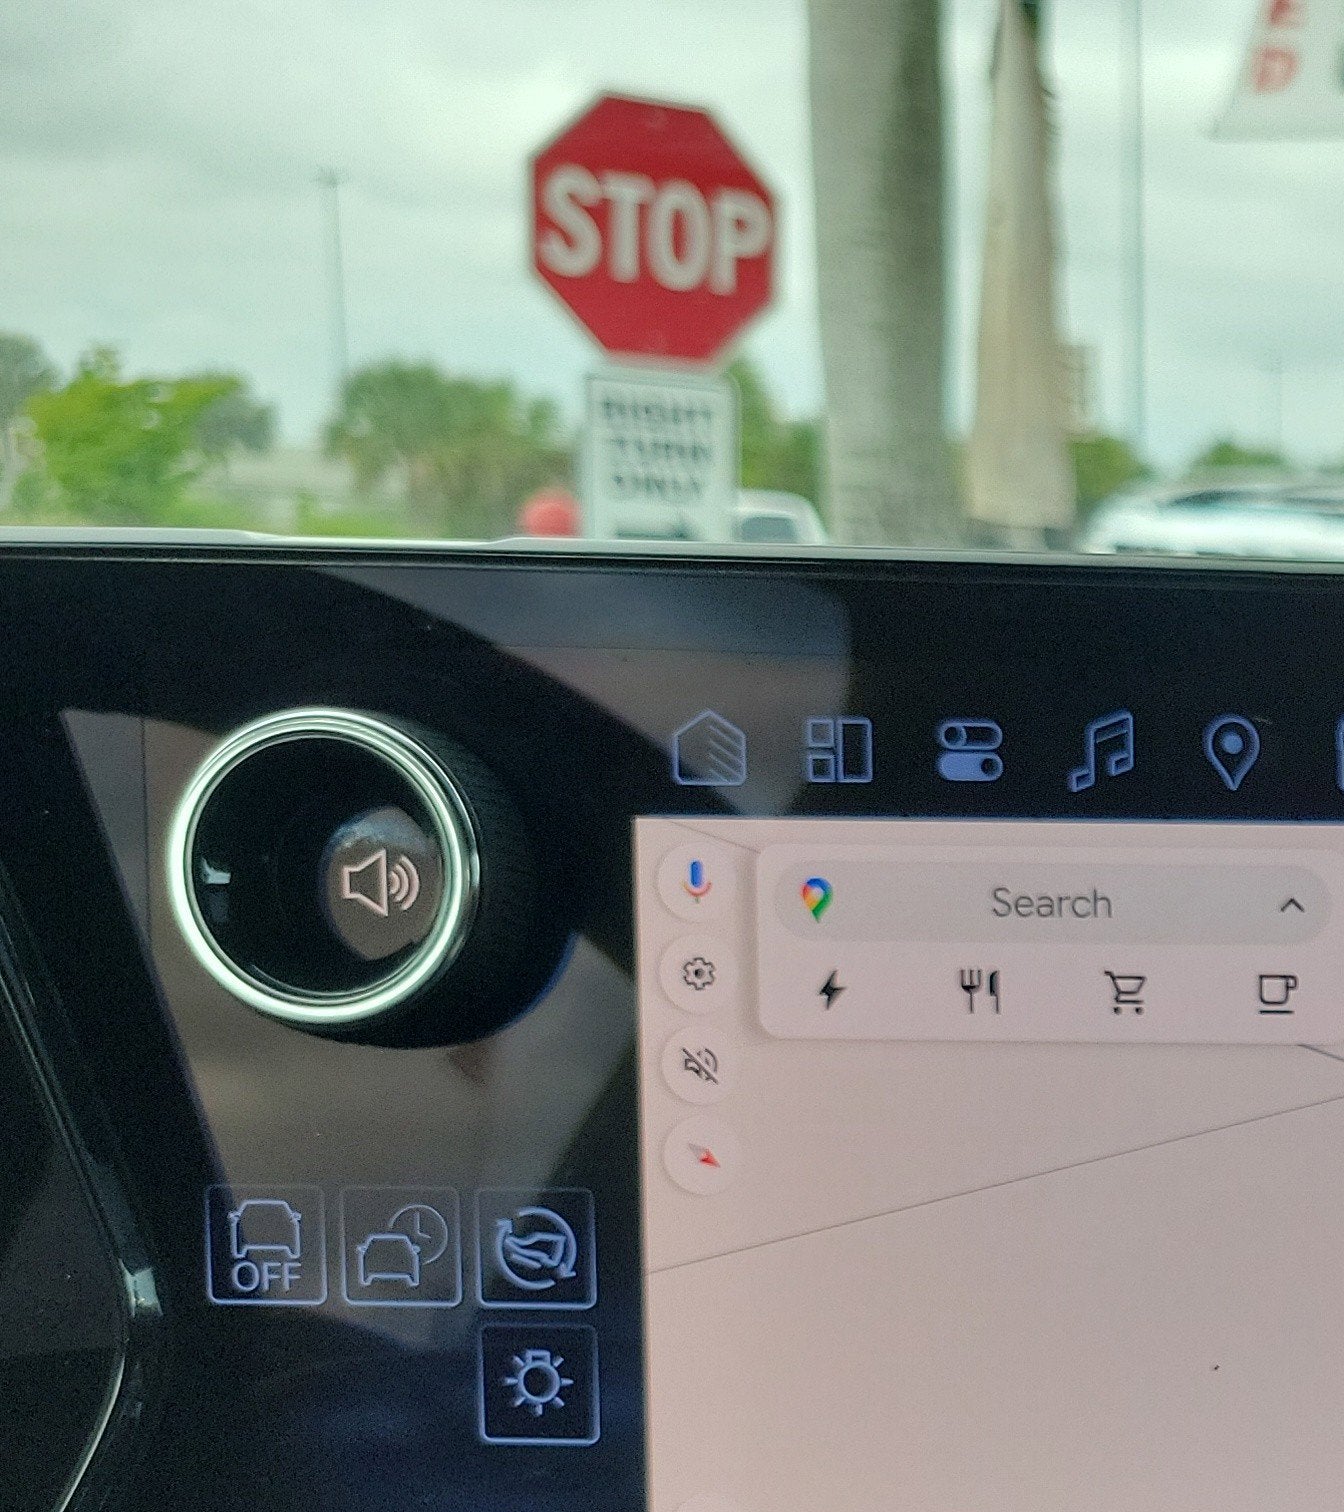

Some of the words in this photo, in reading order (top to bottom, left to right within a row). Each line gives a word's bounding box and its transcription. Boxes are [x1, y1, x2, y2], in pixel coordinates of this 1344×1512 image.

[536, 161, 772, 294] STOP
[991, 886, 1114, 921] Search
[231, 1260, 301, 1292] OFF
